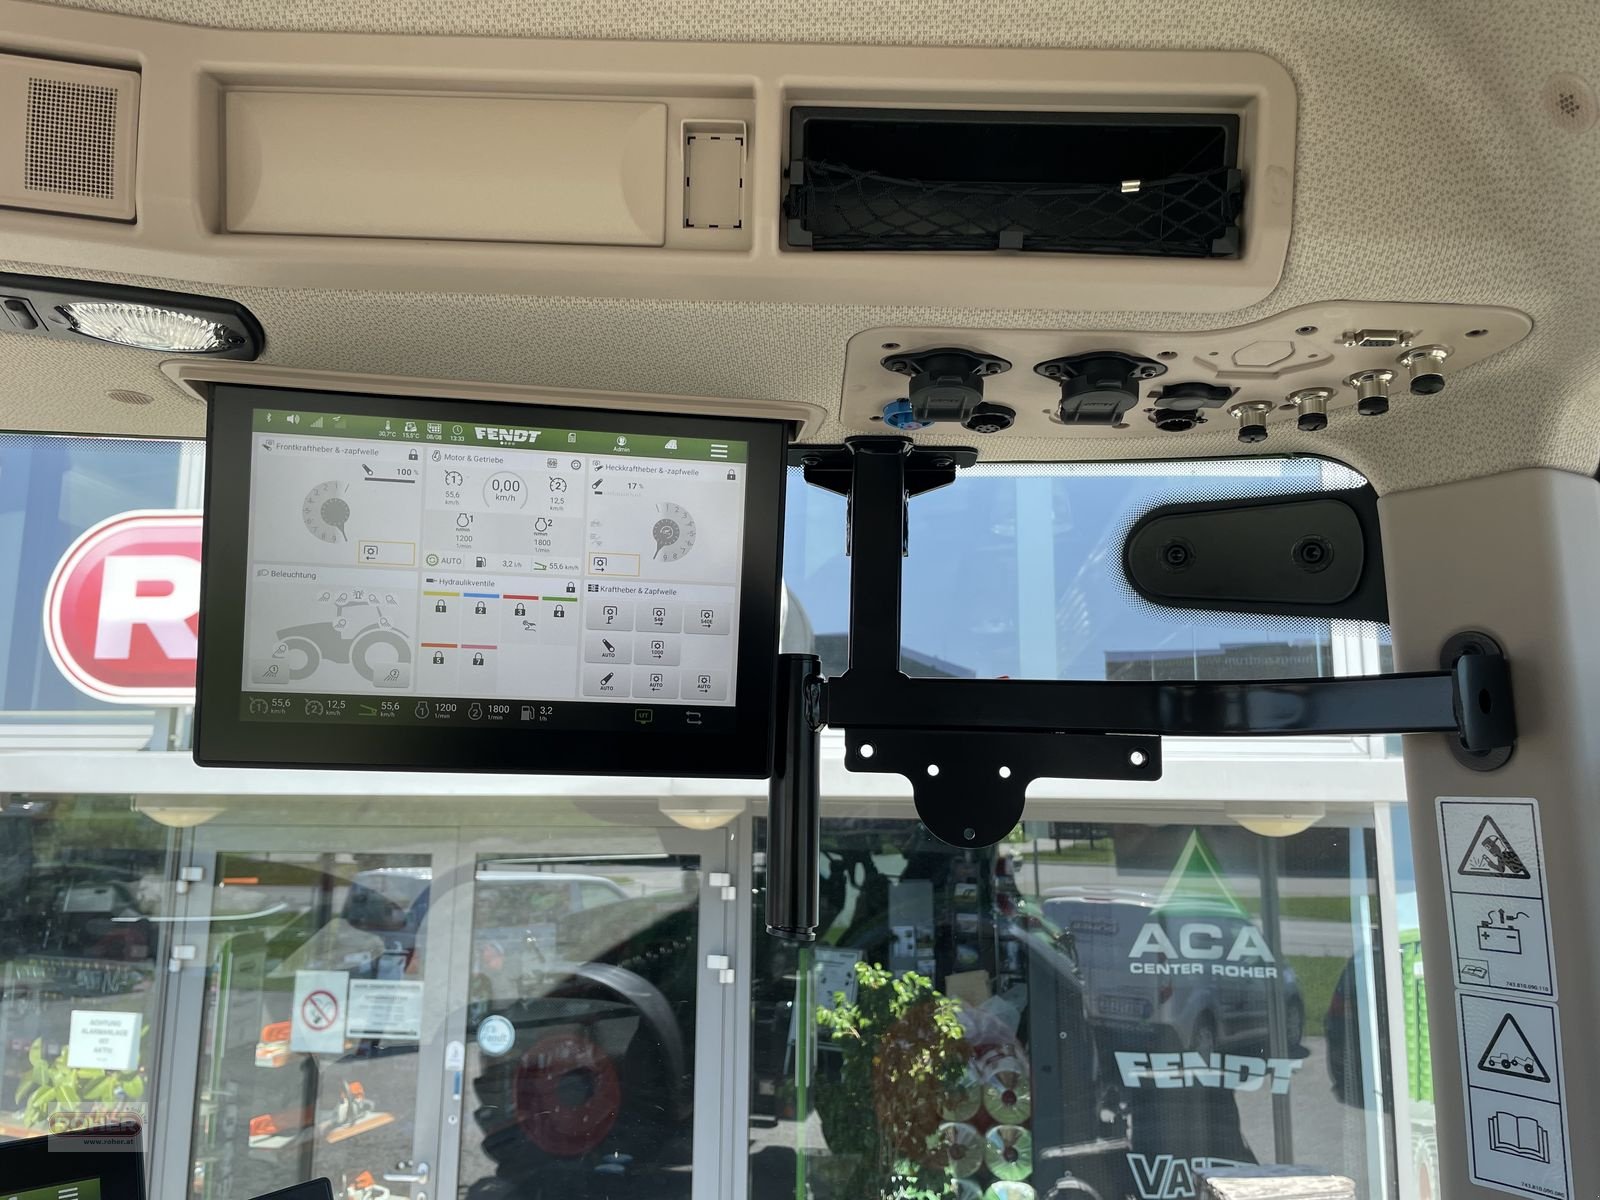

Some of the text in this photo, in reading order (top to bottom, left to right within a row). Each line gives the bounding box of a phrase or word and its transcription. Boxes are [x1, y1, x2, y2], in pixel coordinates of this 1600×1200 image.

[474, 426, 542, 443] FENDT
[276, 442, 333, 453] Frontkraftheber
[444, 453, 465, 462] Motor
[473, 455, 504, 464] Getriebe
[396, 468, 412, 476] 100
[605, 464, 657, 474] Heckkraftheber
[492, 479, 520, 493] 0,00
[445, 491, 460, 499] 55,6
[495, 493, 516, 502] km/h
[550, 497, 565, 505] 12,5
[441, 557, 462, 565] AUTO
[502, 560, 513, 568] 3,2
[549, 562, 564, 570] 55,6
[271, 570, 317, 580] Beleuchtung
[438, 578, 495, 588] Hydraulikventile
[600, 586, 636, 594] Kraftheber
[644, 587, 677, 596] Zapfwelle
[271, 699, 291, 707] 55,6
[327, 700, 346, 709] 12,5
[381, 702, 400, 710] 55,6
[435, 703, 457, 712] 1200
[488, 705, 510, 713] 1800
[539, 706, 553, 715] 3,2
[1128, 922, 1277, 962] ACA
[1130, 962, 1278, 979] CENTER ROHER
[1114, 1051, 1305, 1095] FENDT
